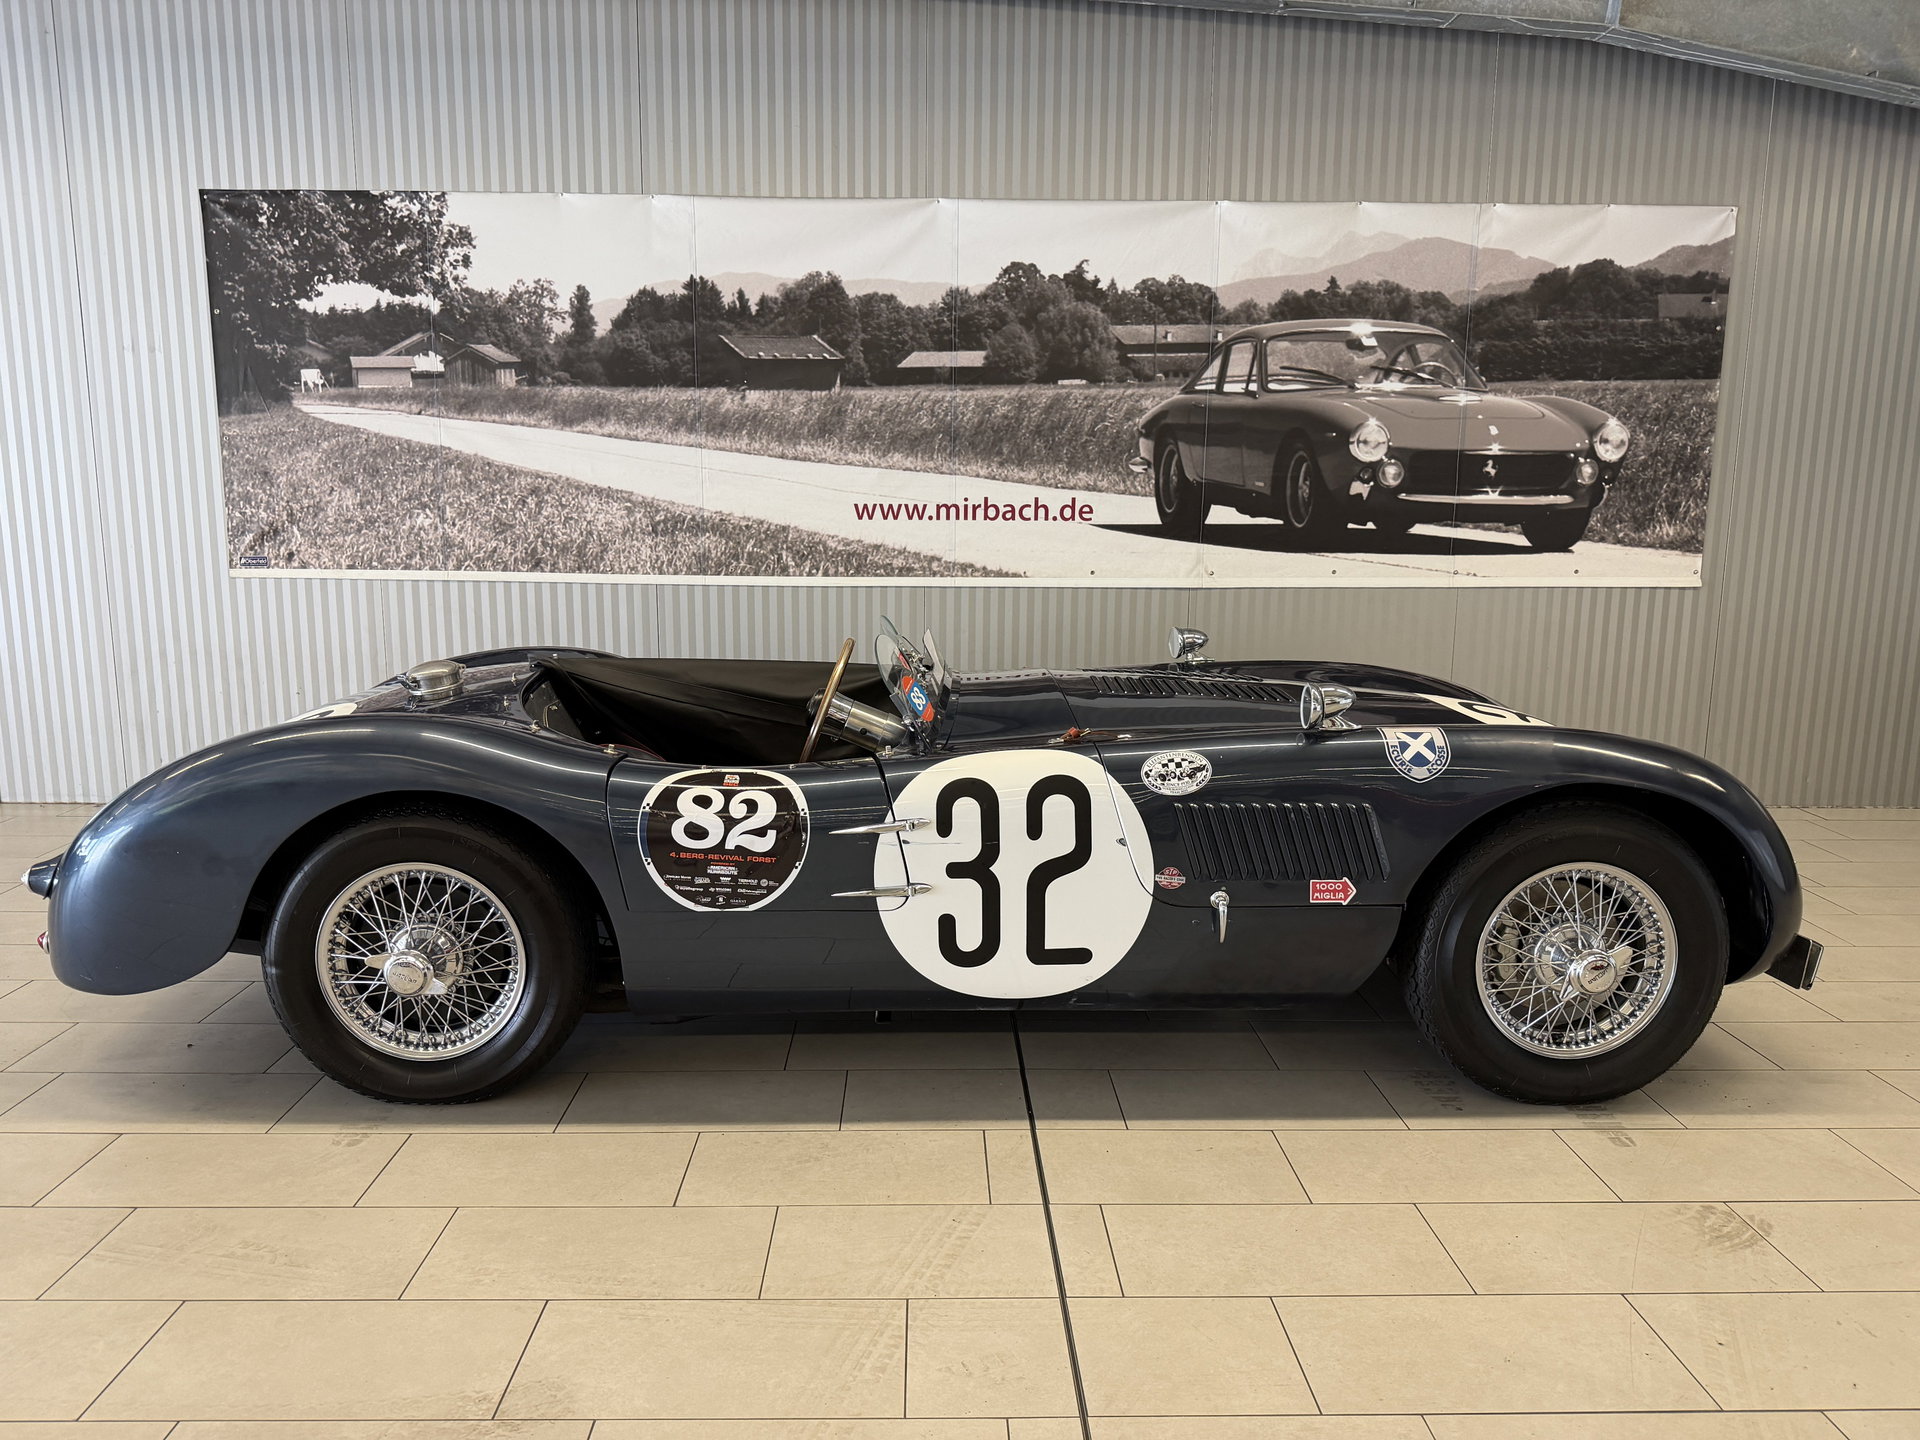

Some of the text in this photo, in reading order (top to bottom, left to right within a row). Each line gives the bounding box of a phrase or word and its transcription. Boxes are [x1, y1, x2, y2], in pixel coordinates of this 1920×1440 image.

[853, 497, 1094, 522] www.mirbach.de
[1390, 744, 1414, 774] ECURIE
[1426, 745, 1445, 775] ECOSSE
[671, 787, 777, 853] 82
[936, 774, 1093, 967] 32
